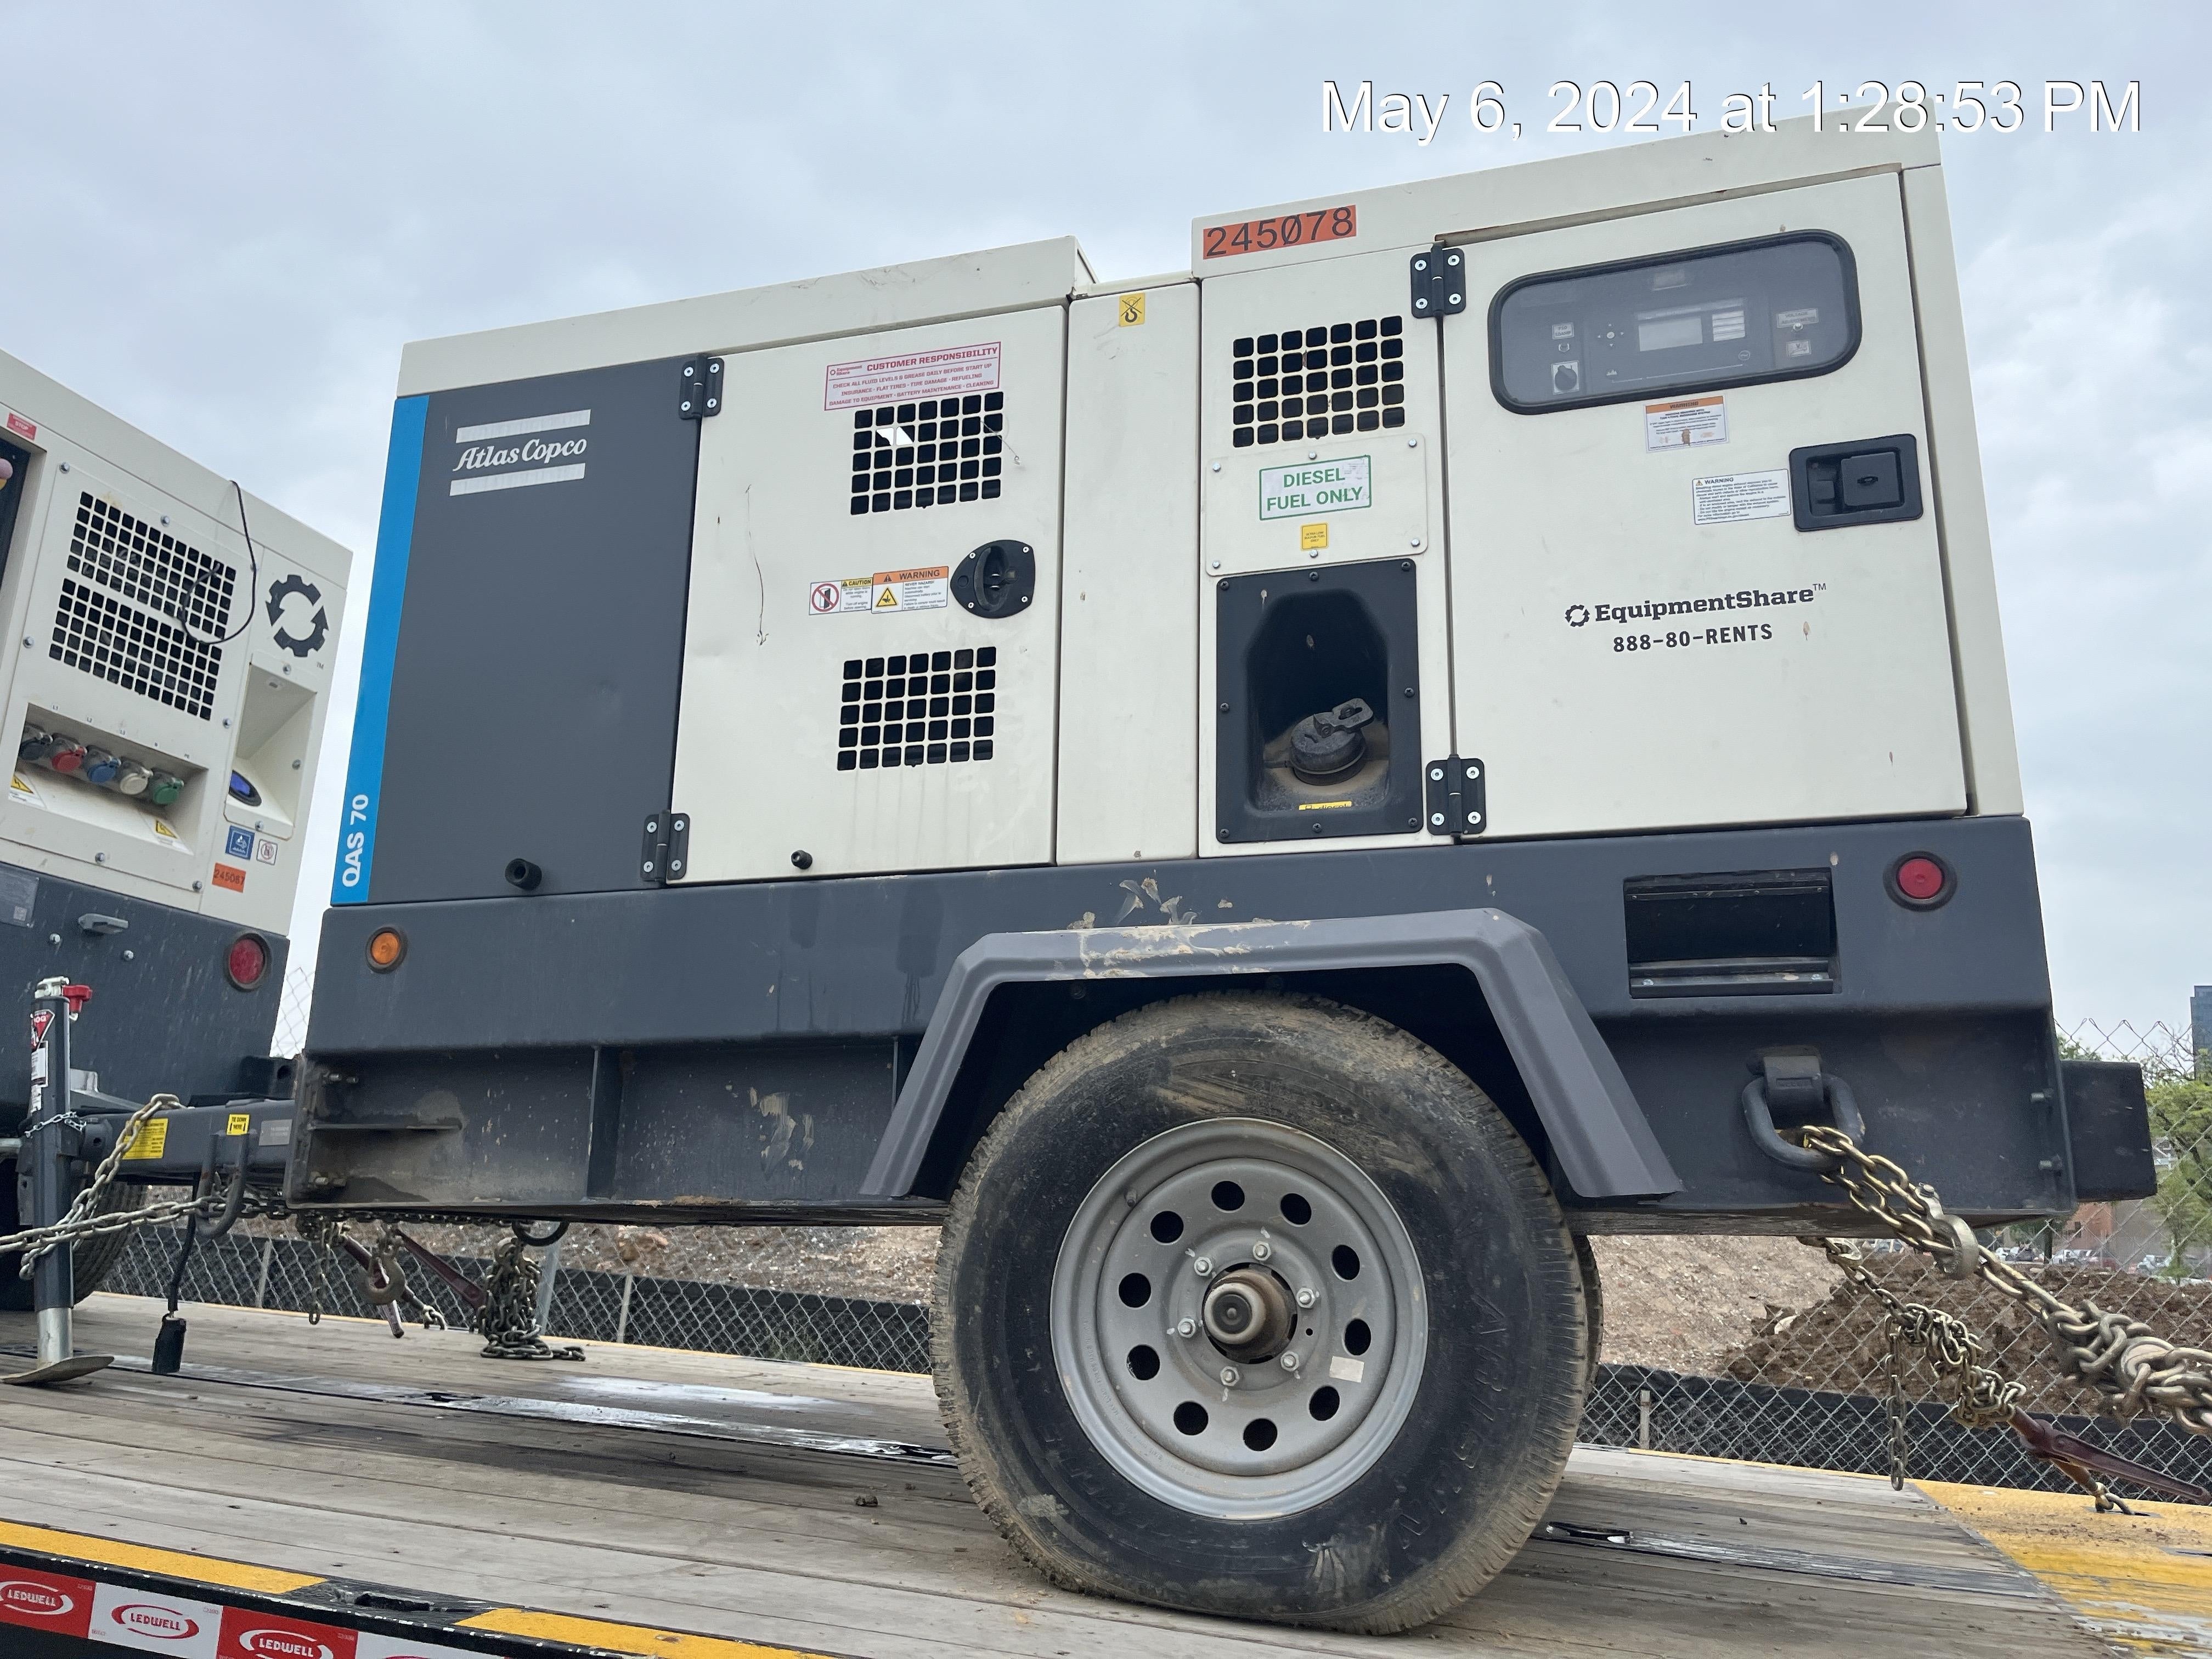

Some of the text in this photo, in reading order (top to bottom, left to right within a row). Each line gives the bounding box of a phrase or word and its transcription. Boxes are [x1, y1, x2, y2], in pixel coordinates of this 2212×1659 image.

[867, 358, 917, 371] CUSTOMER
[919, 347, 998, 364] RESPONSIBILITY
[841, 388, 872, 396] INSURANCE
[951, 373, 983, 381] REFUELING
[861, 393, 893, 402] EQUIPMENT
[922, 384, 962, 394] MAINTENANCE
[452, 438, 587, 472] Atlas Copco
[1283, 467, 1345, 488] DIESEL
[1266, 486, 1363, 511] FUEL ONLY
[900, 569, 940, 580] WARNING
[1595, 589, 1814, 623] EquipmentShare
[1613, 624, 1773, 652] 888-80-RENTS
[342, 794, 369, 888] QAS 70
[7, 1589, 57, 1607] LEDWELL
[130, 1612, 181, 1631] LEDWELL
[258, 1638, 315, 1658] LEDWELL
